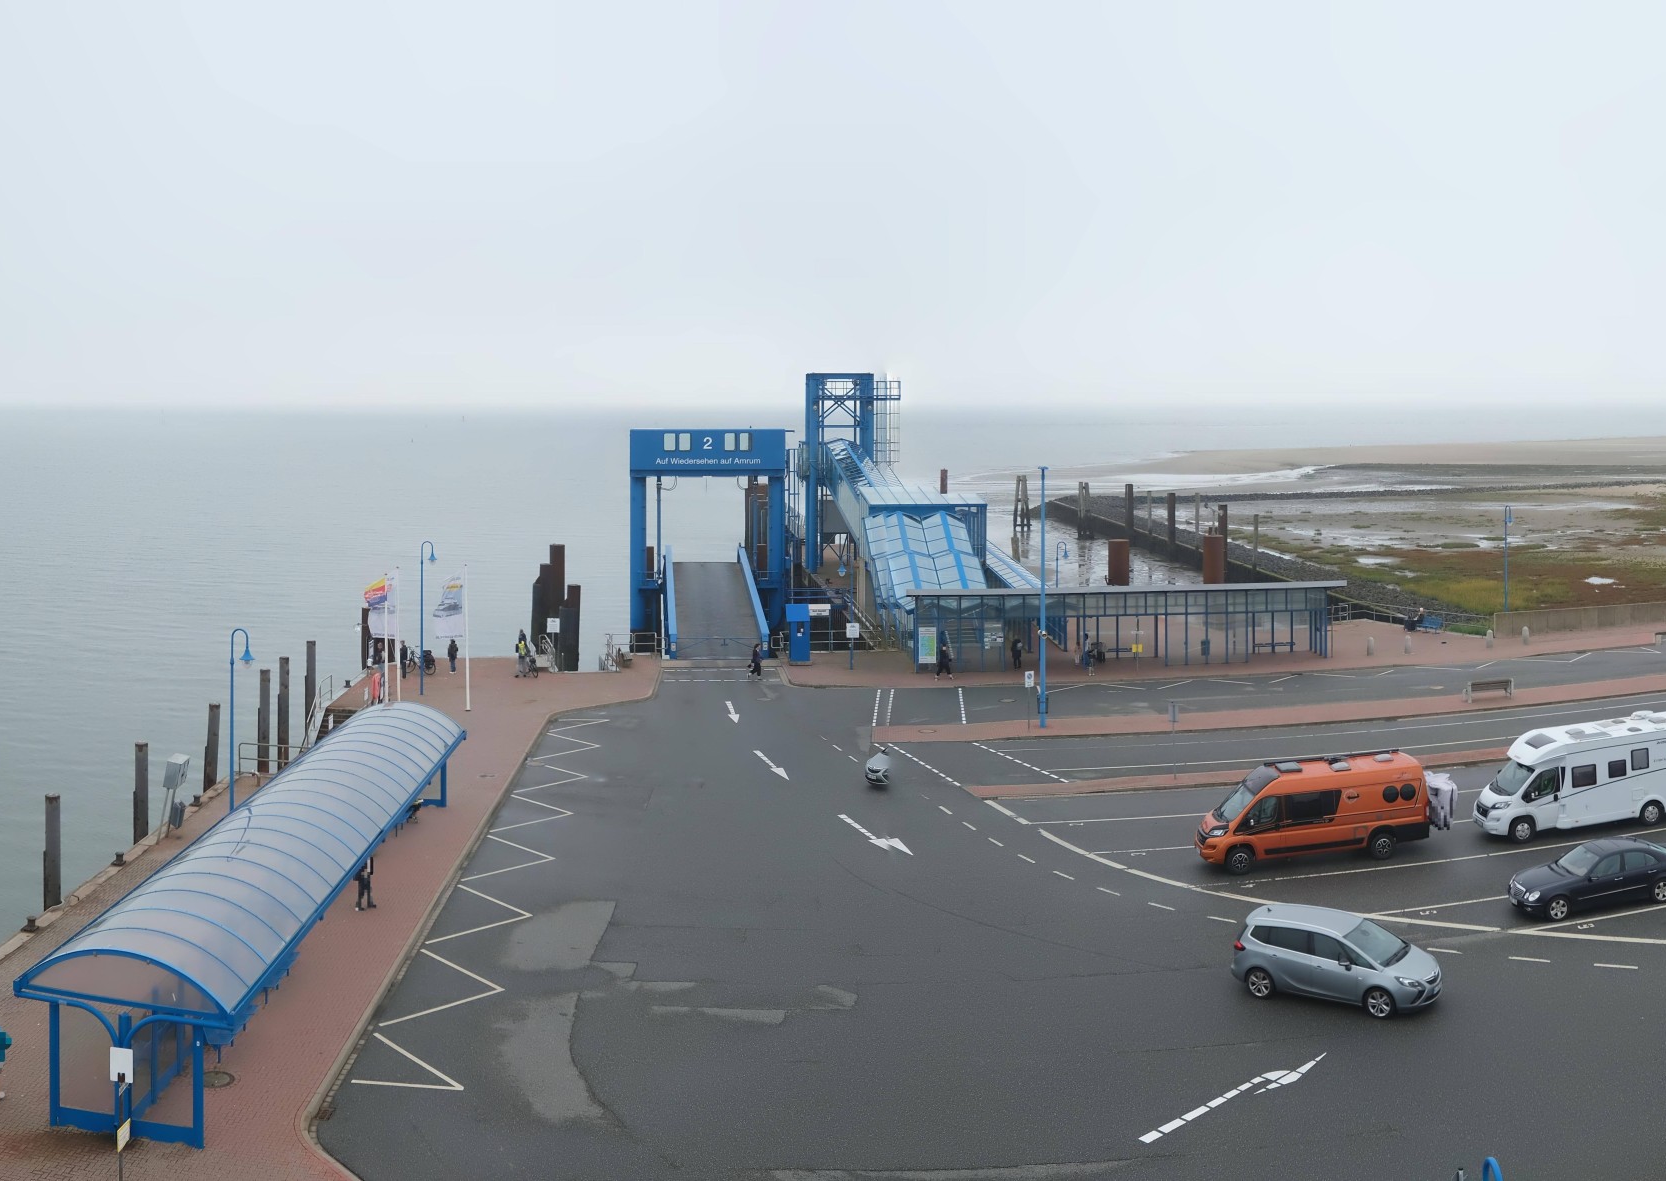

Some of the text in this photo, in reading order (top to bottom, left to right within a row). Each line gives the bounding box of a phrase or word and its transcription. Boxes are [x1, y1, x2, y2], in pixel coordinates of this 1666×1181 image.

[703, 436, 713, 450] 2
[655, 457, 761, 465] Auf Wiedersehen auf Amrum
